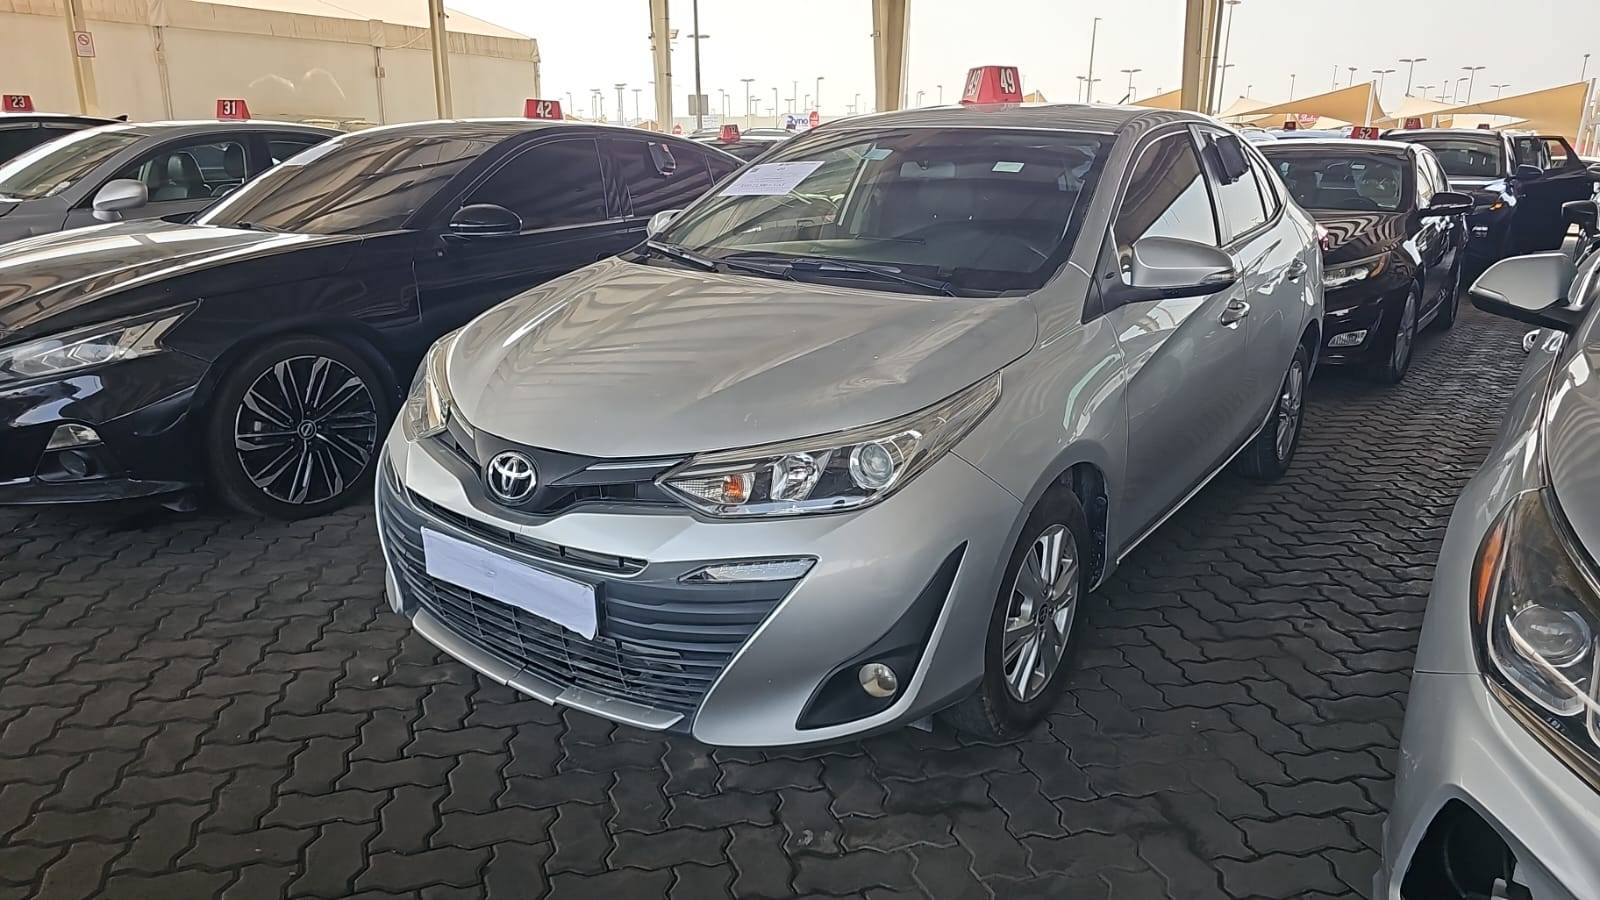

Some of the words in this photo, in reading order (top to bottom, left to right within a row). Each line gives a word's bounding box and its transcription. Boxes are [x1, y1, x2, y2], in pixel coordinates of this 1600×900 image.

[1000, 68, 1016, 94] 49
[11, 96, 26, 108] 23
[223, 100, 236, 115] 31
[536, 101, 553, 118] 42
[1360, 128, 1372, 139] 52
